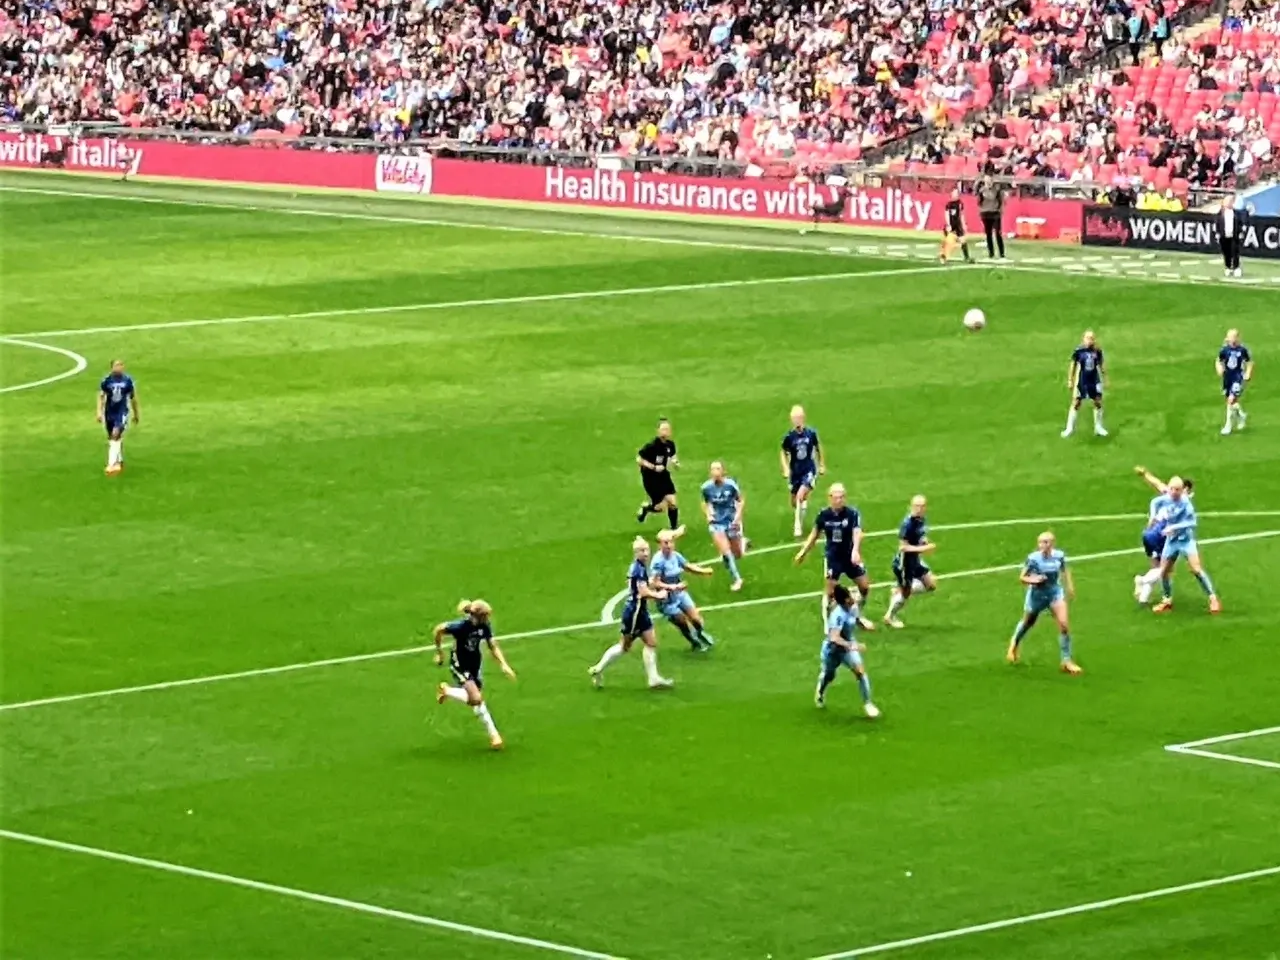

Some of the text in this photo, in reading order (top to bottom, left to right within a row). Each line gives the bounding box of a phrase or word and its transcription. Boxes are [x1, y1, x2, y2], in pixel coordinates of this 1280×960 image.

[381, 155, 427, 193] Vitality
[545, 167, 626, 202] Health
[634, 170, 757, 211] insurance
[1129, 218, 1217, 244] WOMEN'
